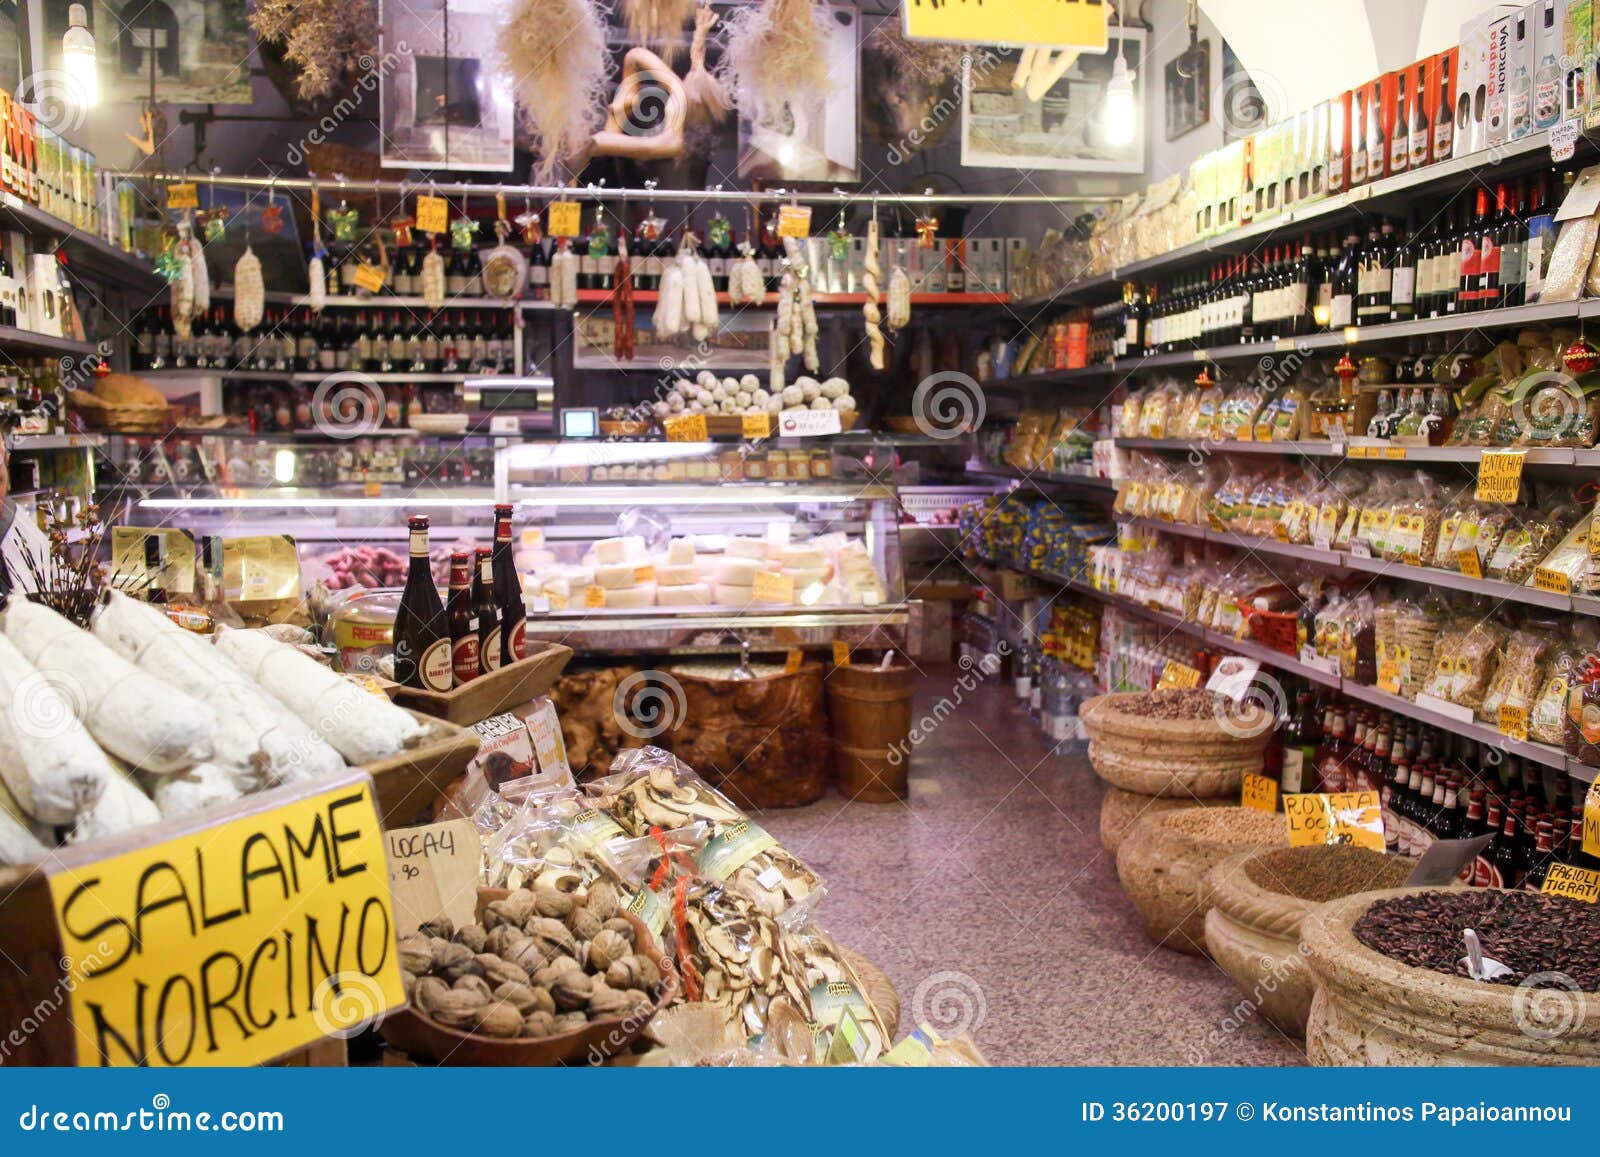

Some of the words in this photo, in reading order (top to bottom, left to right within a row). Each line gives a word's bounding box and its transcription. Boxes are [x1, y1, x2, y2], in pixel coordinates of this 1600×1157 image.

[1498, 25, 1509, 94] NORCINA
[62, 792, 368, 979] SALAME
[1546, 879, 1600, 897] TIGRATI
[1548, 864, 1600, 886] FAGIOLI
[85, 896, 390, 1067] NORCINO
